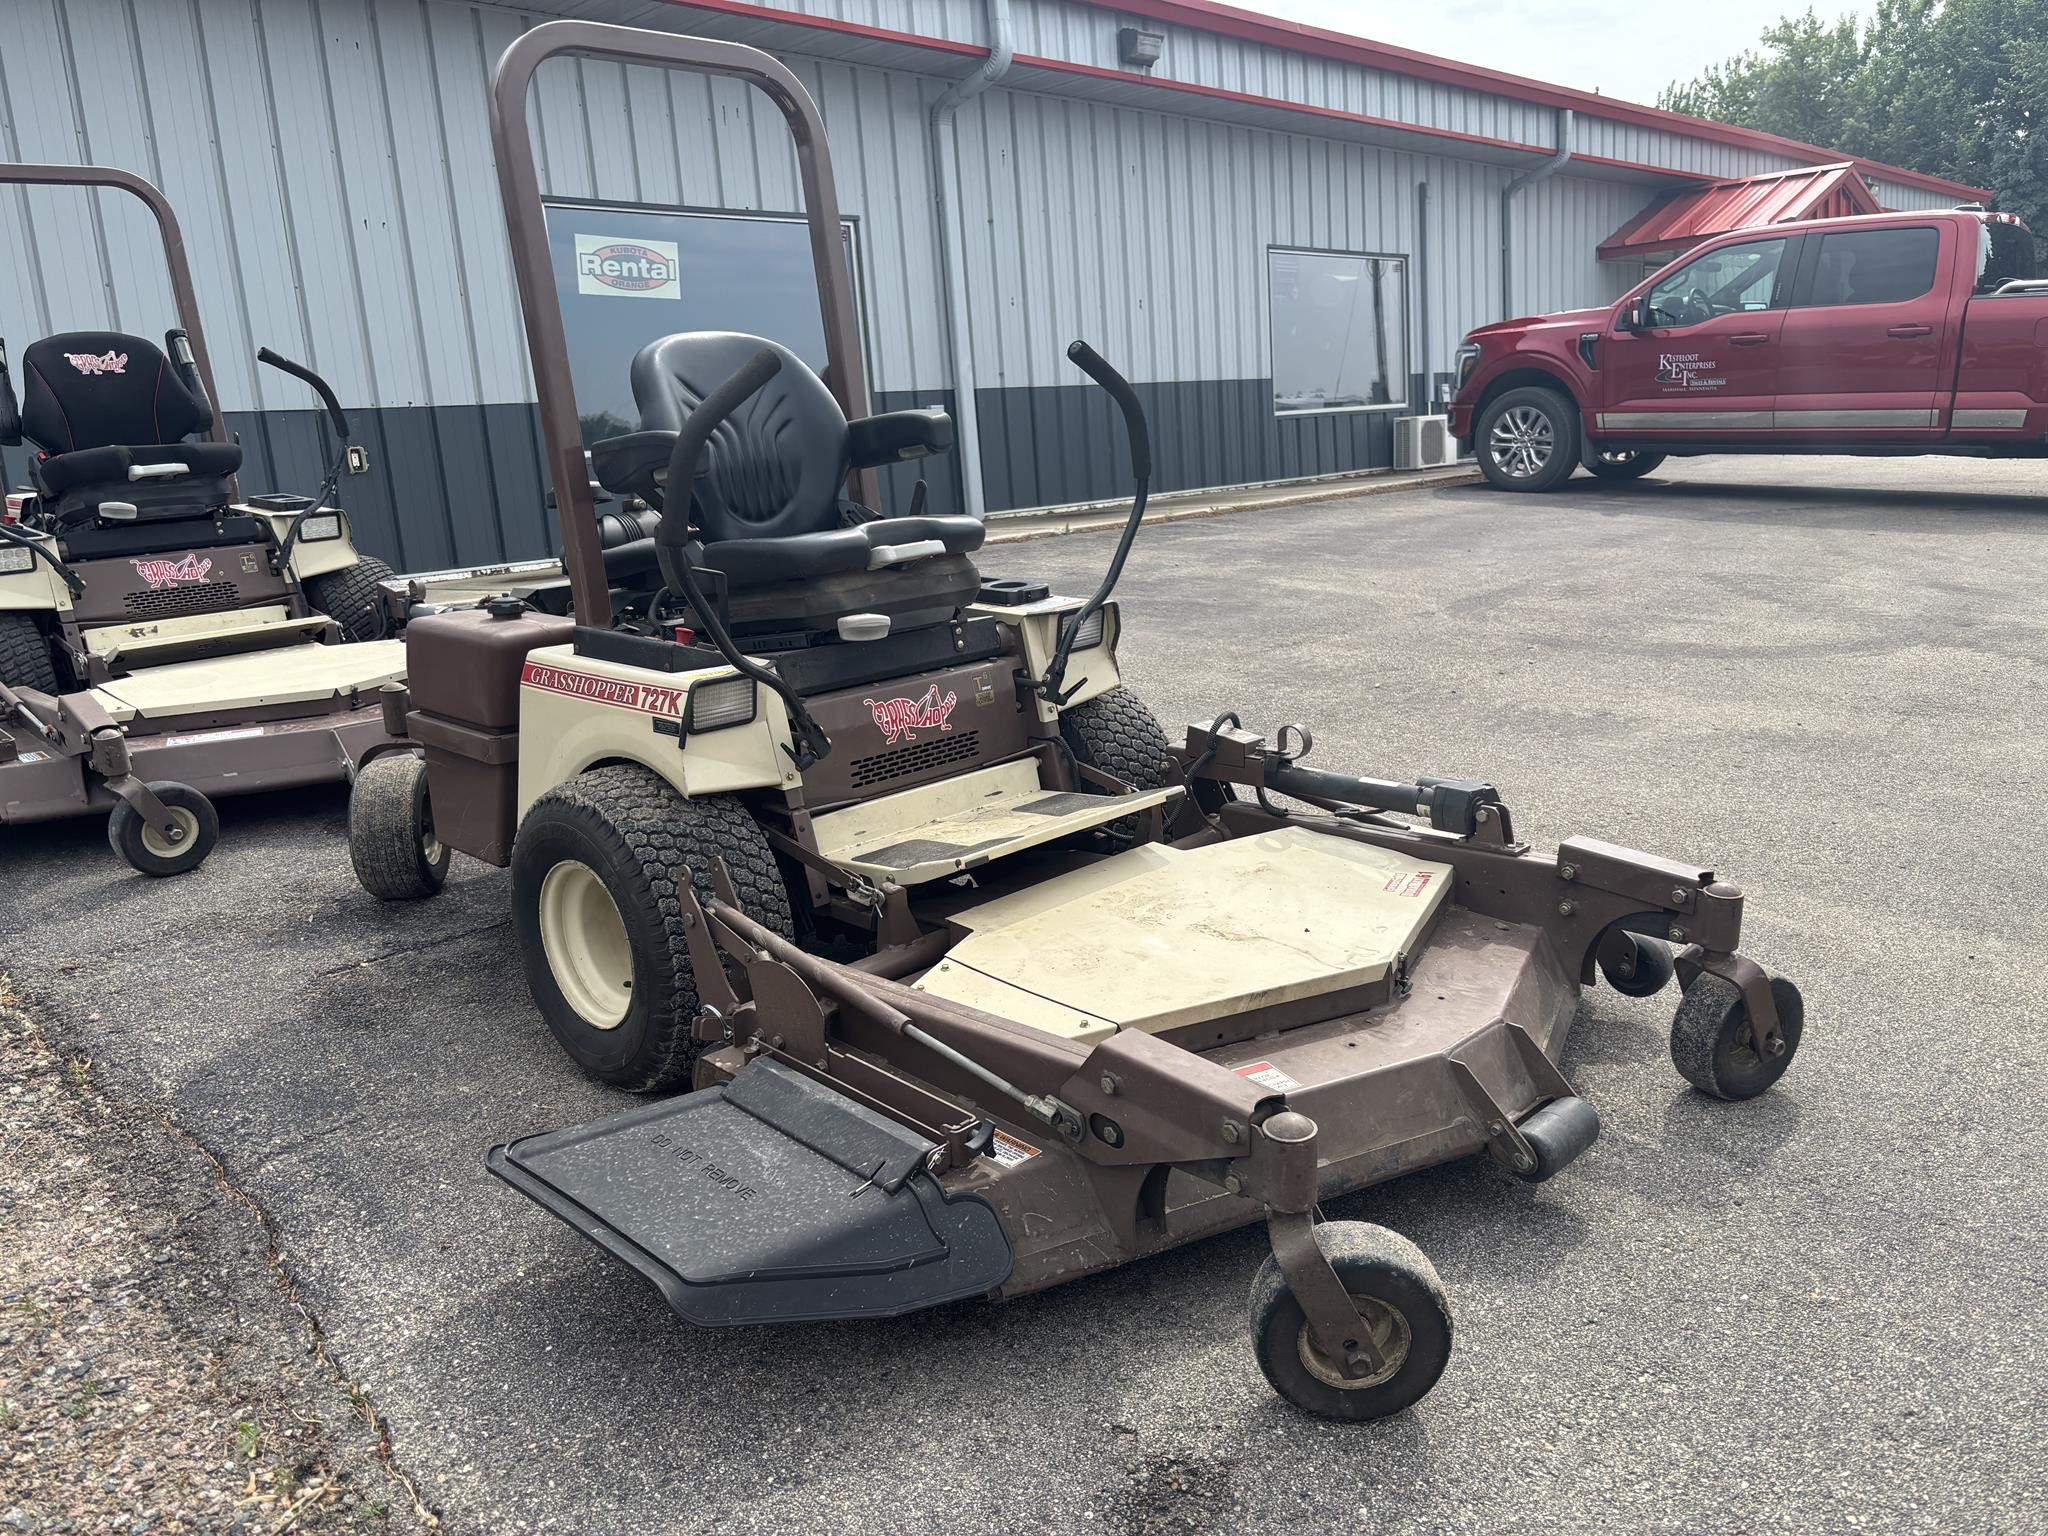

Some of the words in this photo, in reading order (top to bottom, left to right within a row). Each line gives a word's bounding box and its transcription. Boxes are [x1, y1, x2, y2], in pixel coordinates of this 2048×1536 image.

[609, 247, 648, 257] KUBOTA
[581, 254, 676, 280] Rental
[610, 280, 650, 289] ORANGE
[1671, 360, 1716, 379] ENTERPRISES
[531, 667, 636, 704] GRASSHOPPER
[640, 686, 682, 715] 727K
[870, 684, 958, 738] GRASSHOPPER
[650, 1134, 673, 1148] DO
[672, 1146, 703, 1167] NOT
[701, 1163, 757, 1201] REMOVE
